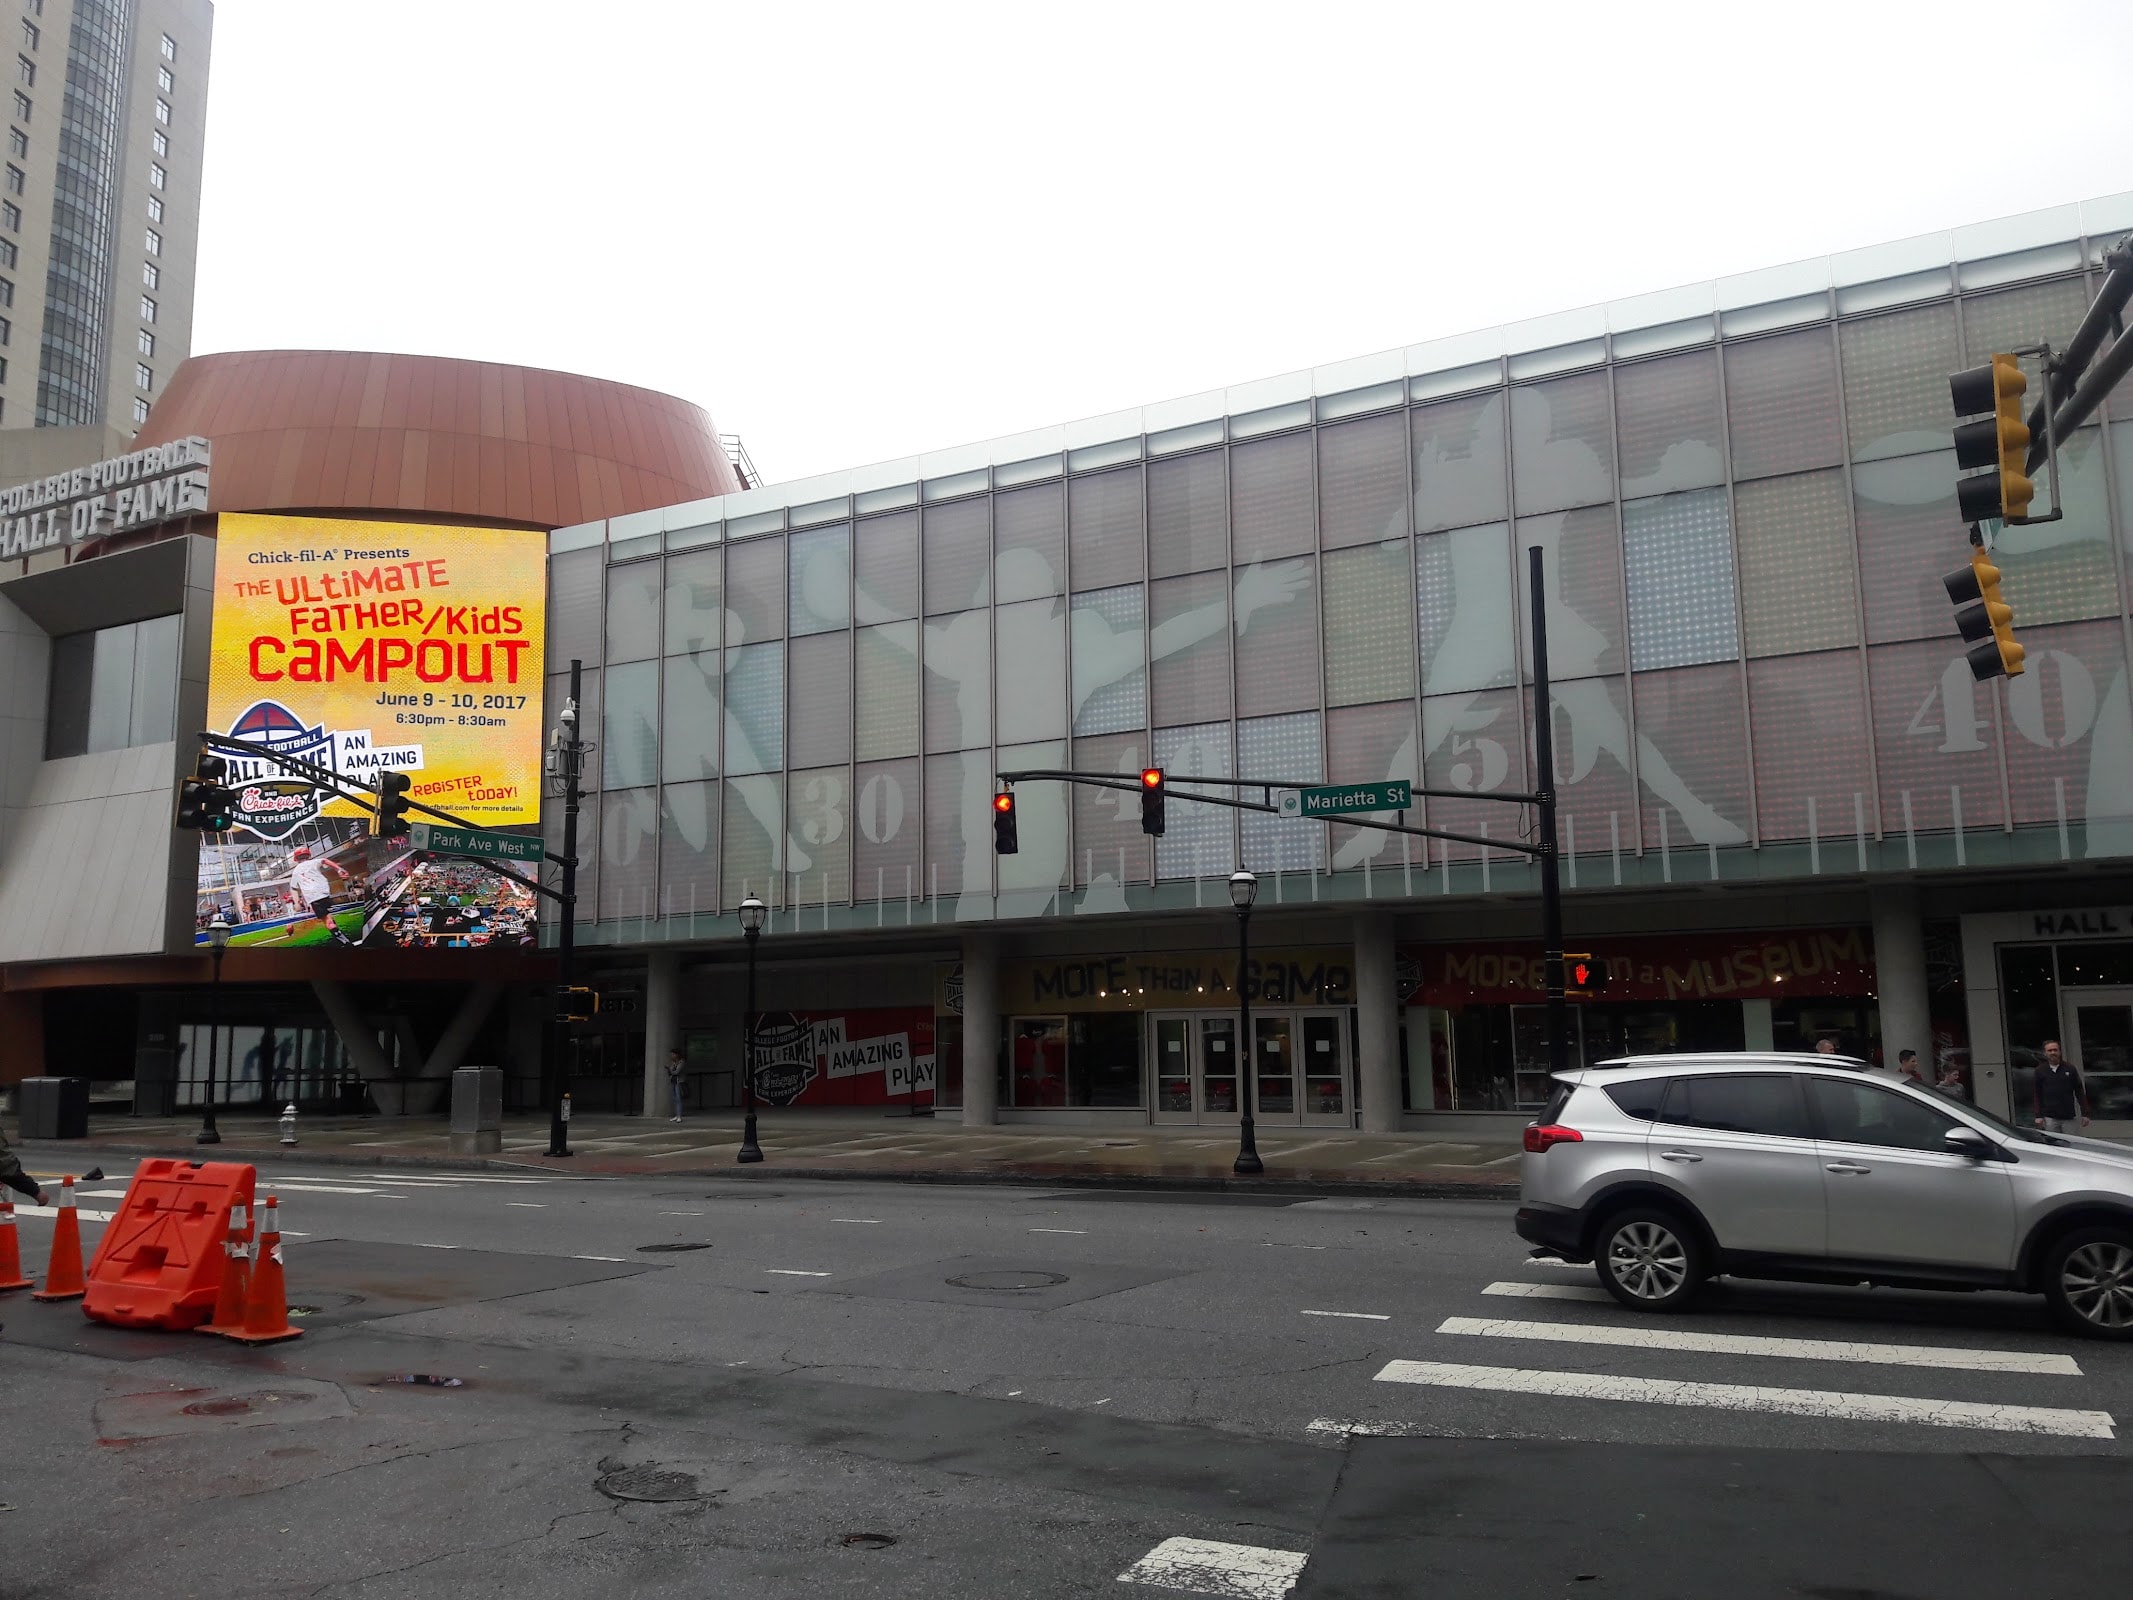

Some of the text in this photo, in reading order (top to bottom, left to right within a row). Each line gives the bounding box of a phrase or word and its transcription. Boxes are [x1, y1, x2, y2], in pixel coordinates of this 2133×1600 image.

[89, 437, 197, 492] FOOTBALL
[0, 473, 195, 557] HALL OF FAME
[344, 548, 410, 560] Presents
[376, 692, 418, 706] June
[423, 693, 434, 707] 9
[451, 694, 478, 710] 10,
[483, 695, 527, 709] 2017
[396, 713, 445, 727] 6:30pm
[458, 715, 506, 727] 8:30am
[344, 735, 365, 750] AN
[346, 751, 417, 769] AMAZING
[223, 759, 264, 787] ALL
[803, 773, 904, 845] 30
[1307, 788, 1405, 809] Marietta St
[232, 803, 314, 824] FAN EXPERIENCE
[433, 832, 461, 848] Park
[468, 837, 491, 852] Ave
[498, 839, 525, 855] West
[2034, 912, 2118, 935] HALL
[818, 1026, 841, 1047] AN
[833, 1041, 903, 1070] AMAZING
[892, 1062, 935, 1086] PLAY
